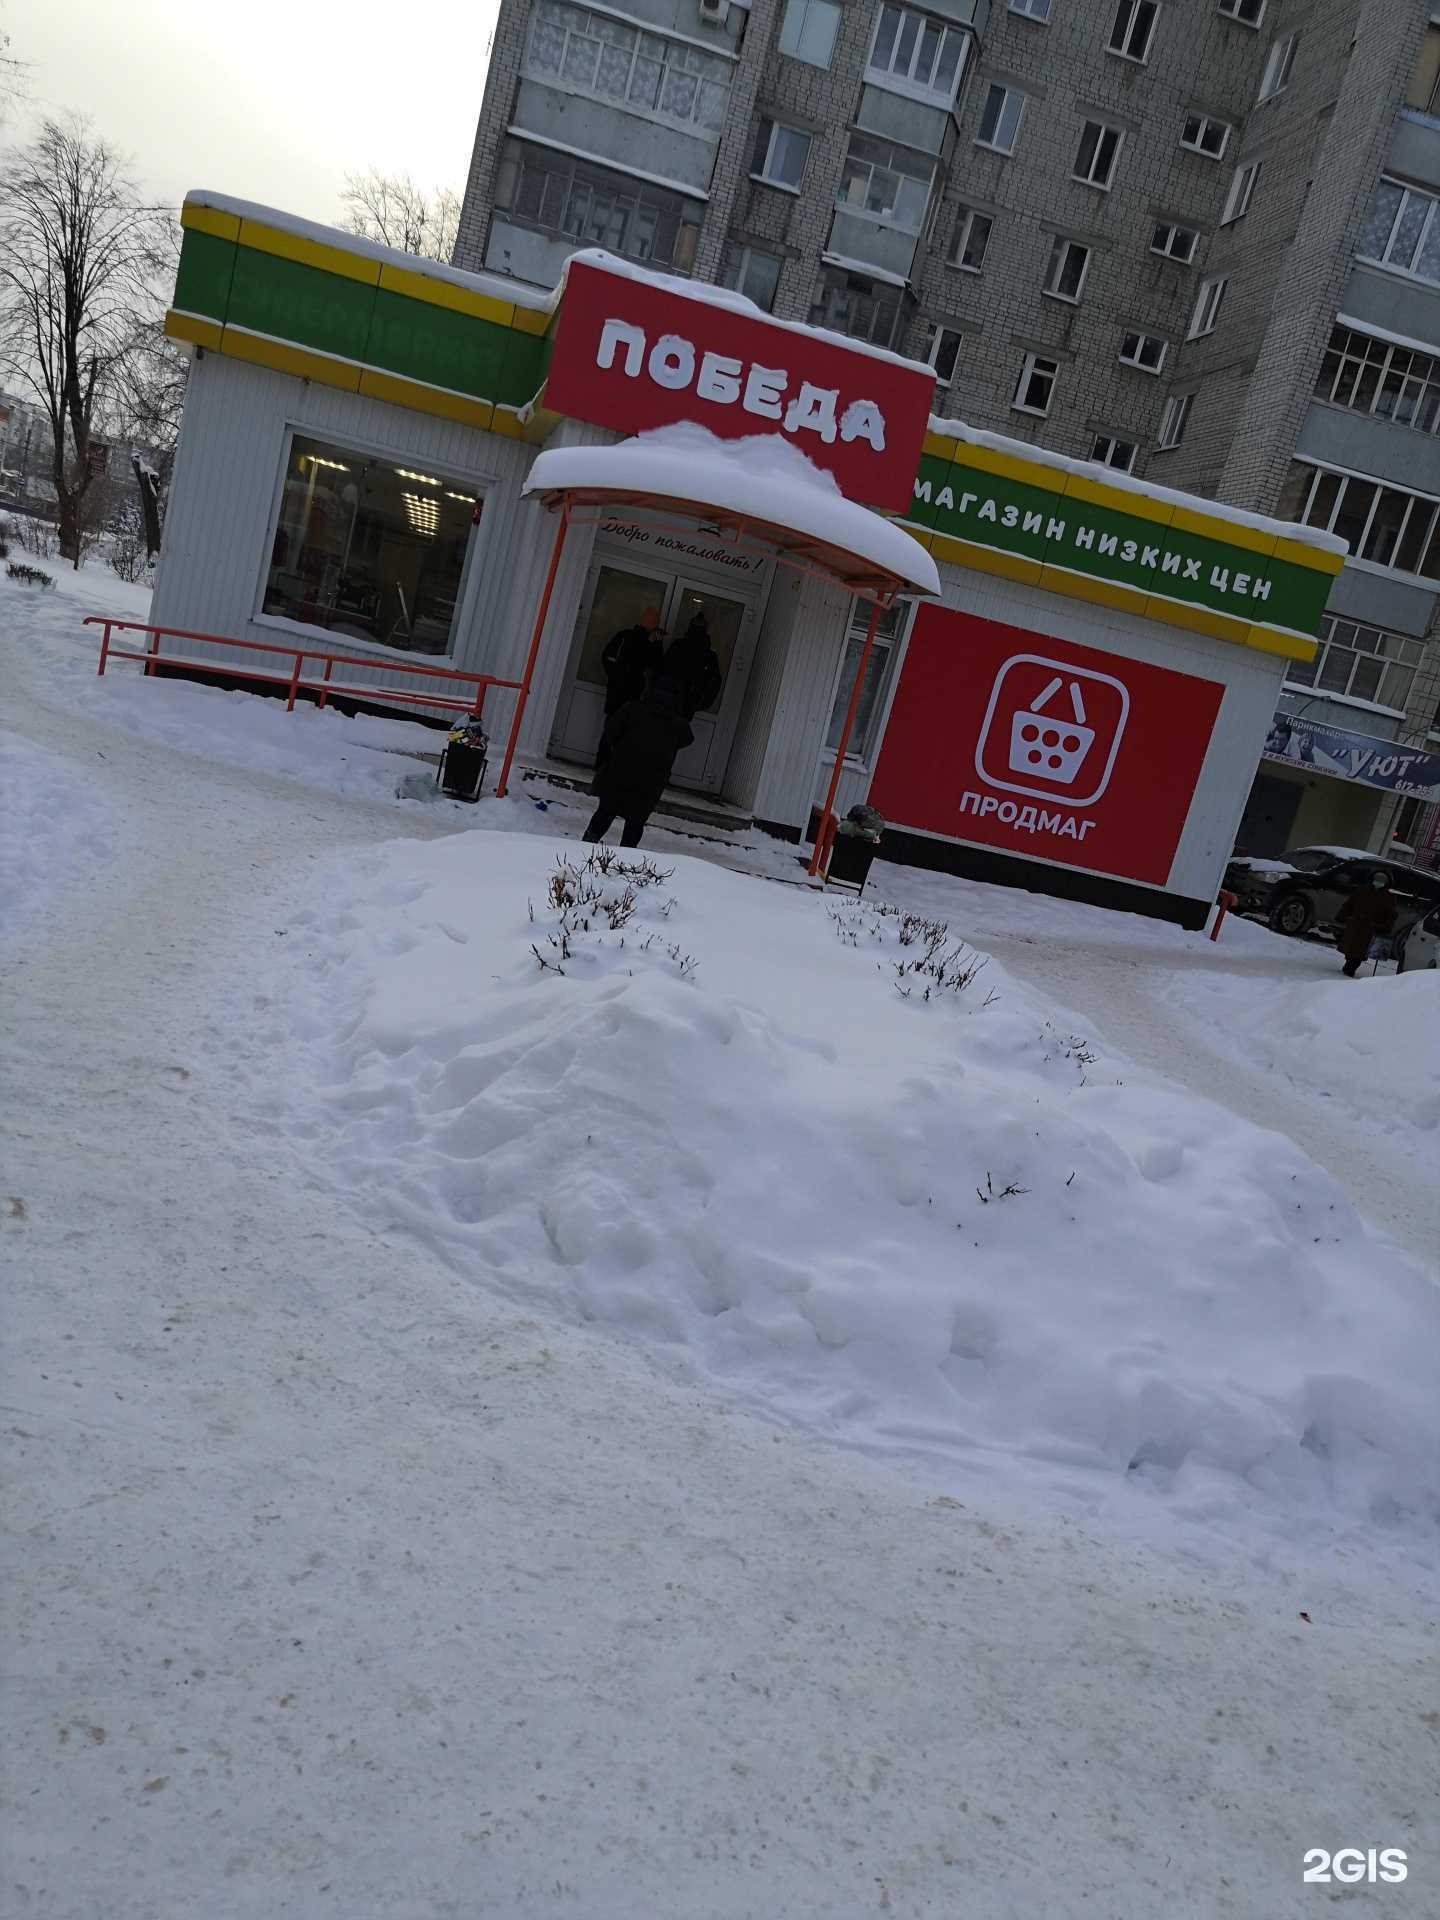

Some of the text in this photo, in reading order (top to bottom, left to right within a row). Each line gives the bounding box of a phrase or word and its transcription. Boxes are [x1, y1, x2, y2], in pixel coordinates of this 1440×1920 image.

[596, 318, 886, 452] ПОБЕДА
[601, 517, 650, 543] Добро
[913, 477, 1273, 601] МАГАЗИН НИЗКИХ ЦЕН
[959, 790, 1097, 842] ПРОДМАГ
